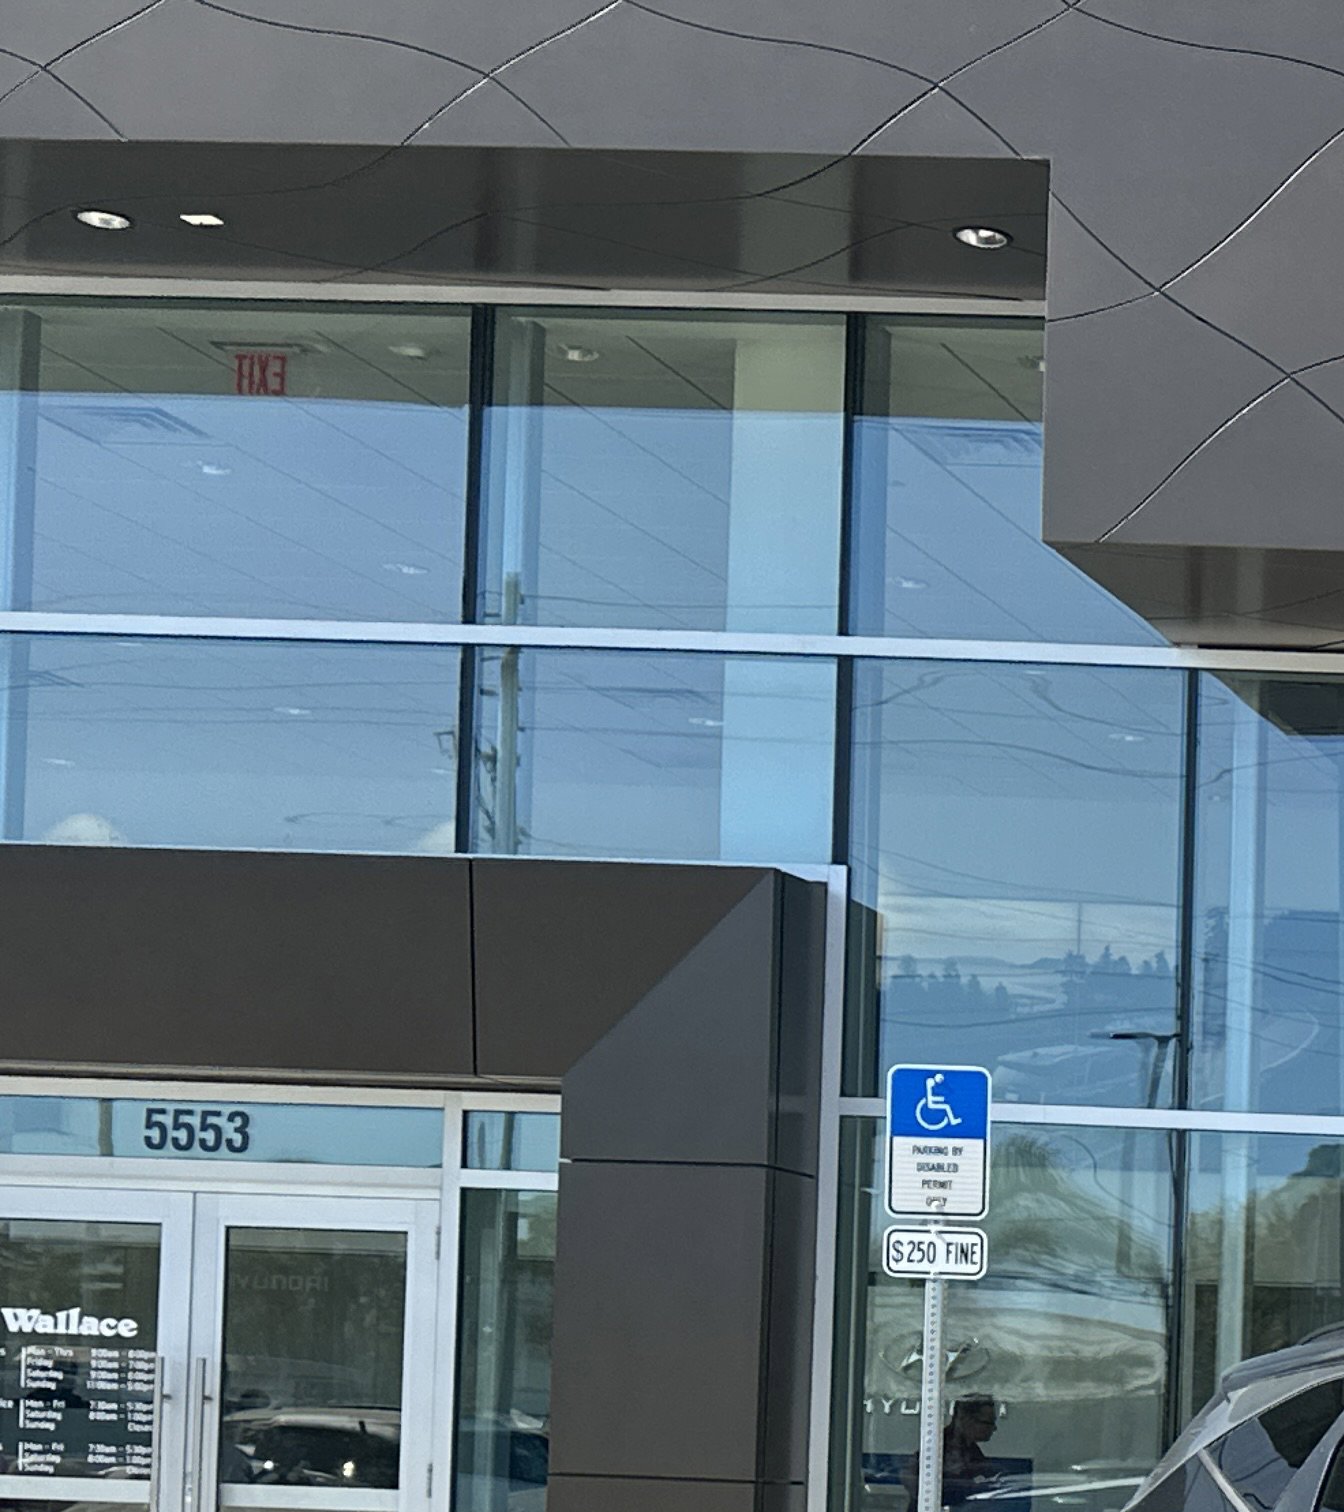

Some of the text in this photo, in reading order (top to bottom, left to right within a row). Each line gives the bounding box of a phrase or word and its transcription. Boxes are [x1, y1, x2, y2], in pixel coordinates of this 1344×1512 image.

[144, 1107, 250, 1153] 5553
[912, 1145, 963, 1156] PARKING BY
[916, 1162, 959, 1173] DISABLED
[921, 1179, 952, 1190] PERMIT
[891, 1240, 979, 1265] $250 FINE
[1, 1307, 138, 1338] Wallace
